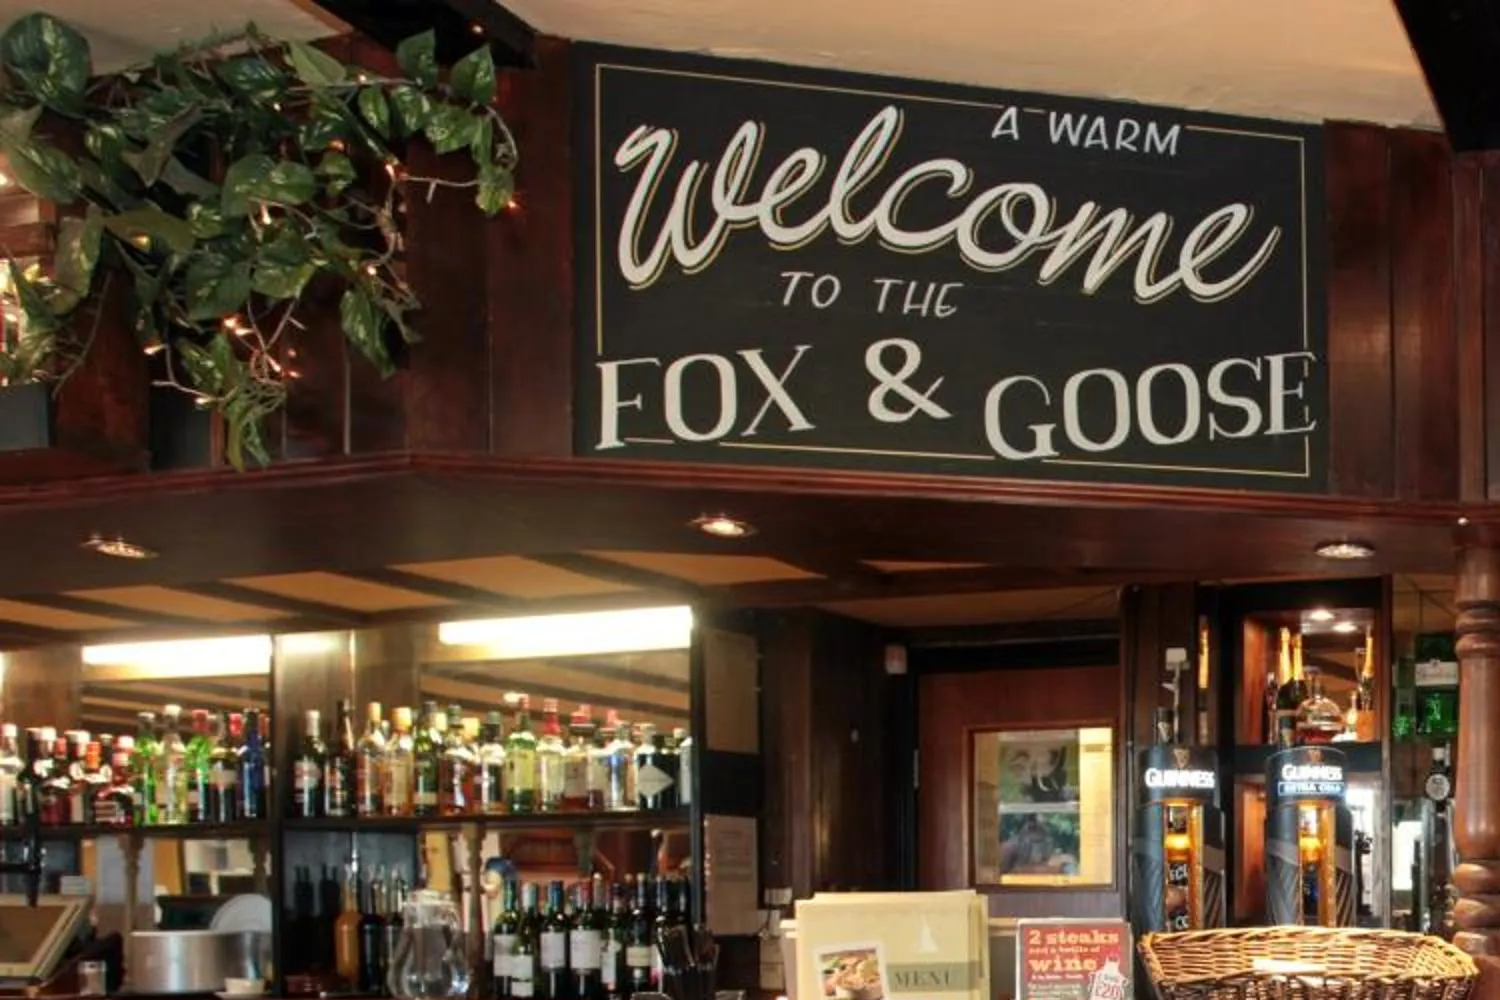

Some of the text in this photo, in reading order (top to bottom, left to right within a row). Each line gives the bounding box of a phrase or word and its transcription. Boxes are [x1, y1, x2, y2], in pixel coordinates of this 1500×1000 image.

[991, 107, 1181, 156] A WARM
[614, 104, 1282, 304] Welcome
[781, 270, 964, 318] TO THE
[594, 336, 1318, 461] FOX & GOOSE
[1145, 767, 1215, 788] GUINNESS
[1029, 929, 1119, 945] 2 steaks
[1028, 953, 1099, 972] wine
